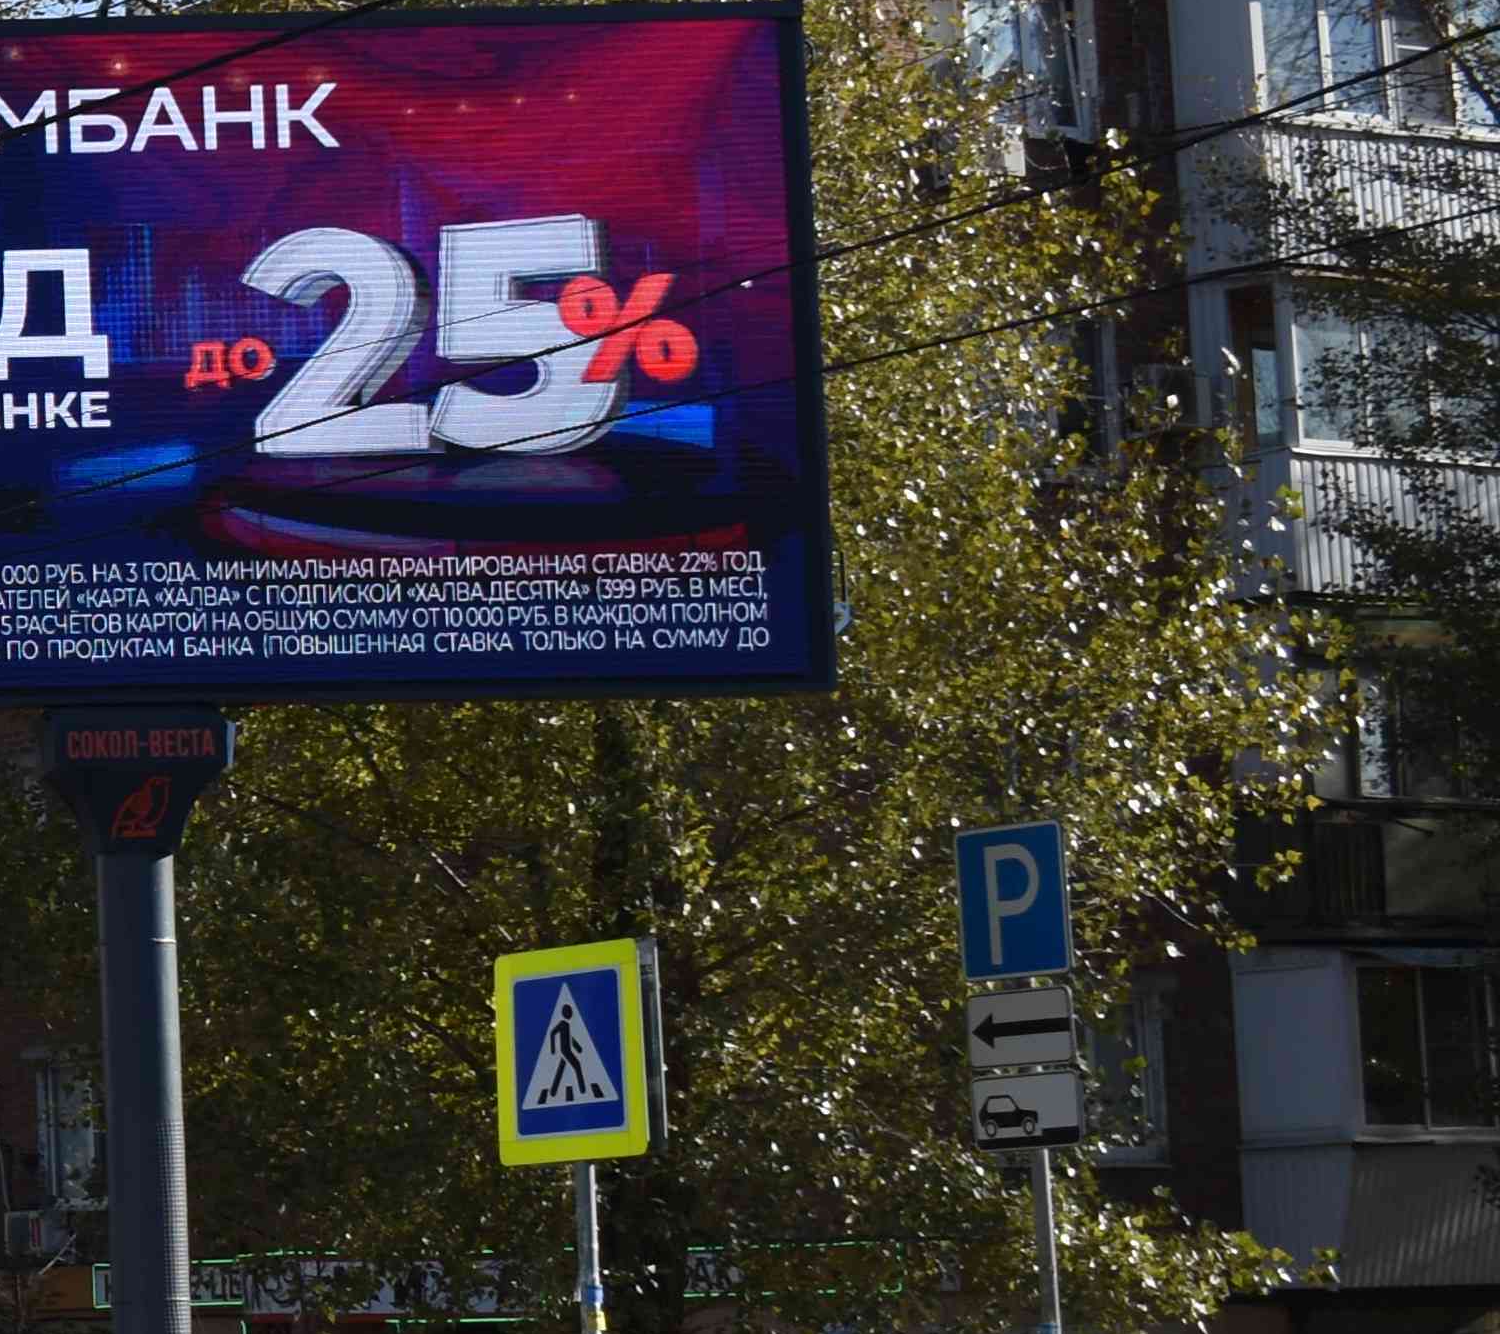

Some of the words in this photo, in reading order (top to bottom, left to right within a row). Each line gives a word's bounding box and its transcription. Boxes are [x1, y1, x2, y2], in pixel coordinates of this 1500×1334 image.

[241, 214, 698, 457] 25%
[2, 564, 39, 585] 000
[46, 564, 87, 585] РУБ.
[92, 563, 123, 584] НА
[125, 562, 139, 583] 3
[143, 561, 201, 585] ГОДА.
[206, 557, 374, 581] МИНИМАЛЬНАЯ
[379, 554, 586, 578] ГАРАНТИРОВАННАЯ
[591, 552, 675, 574] СТАВКА:
[679, 551, 718, 573] 22%
[722, 551, 767, 574] ГОД.
[76, 587, 149, 609] «КАРТА
[155, 585, 240, 607] «ХАЛВА»
[246, 585, 261, 605] С
[266, 579, 401, 608] ПОДПИСКОЙ
[596, 576, 636, 602] (399
[640, 578, 685, 600] РУБ.
[689, 577, 703, 598] В
[0, 615, 13, 636] 5
[126, 607, 206, 633] КАРТОЙ
[212, 612, 242, 632] НА
[244, 610, 331, 634] ОБЩУЮ
[333, 608, 409, 630] СУММУ
[412, 608, 440, 629] ОТ
[442, 607, 464, 628] 10
[466, 607, 504, 628] 000
[507, 606, 550, 627] РУБ.
[554, 606, 568, 626] В
[572, 604, 666, 628] КАЖДОМ
[670, 603, 768, 624] ПОЛНОМ
[6, 640, 39, 660] ПО
[47, 637, 175, 662] ПРОДУКТАМ
[184, 637, 254, 657] БАНКА
[262, 633, 426, 658] (ПОВЫШЕННАЯ
[434, 632, 514, 653] СТАВКА
[520, 630, 606, 651] ТОЛЬКО
[614, 630, 646, 651] НА
[653, 629, 730, 650] СУММУ
[736, 628, 770, 652] ДО
[67, 730, 216, 759] СОКОЛ-ВЕСТА
[984, 844, 1039, 965] P
